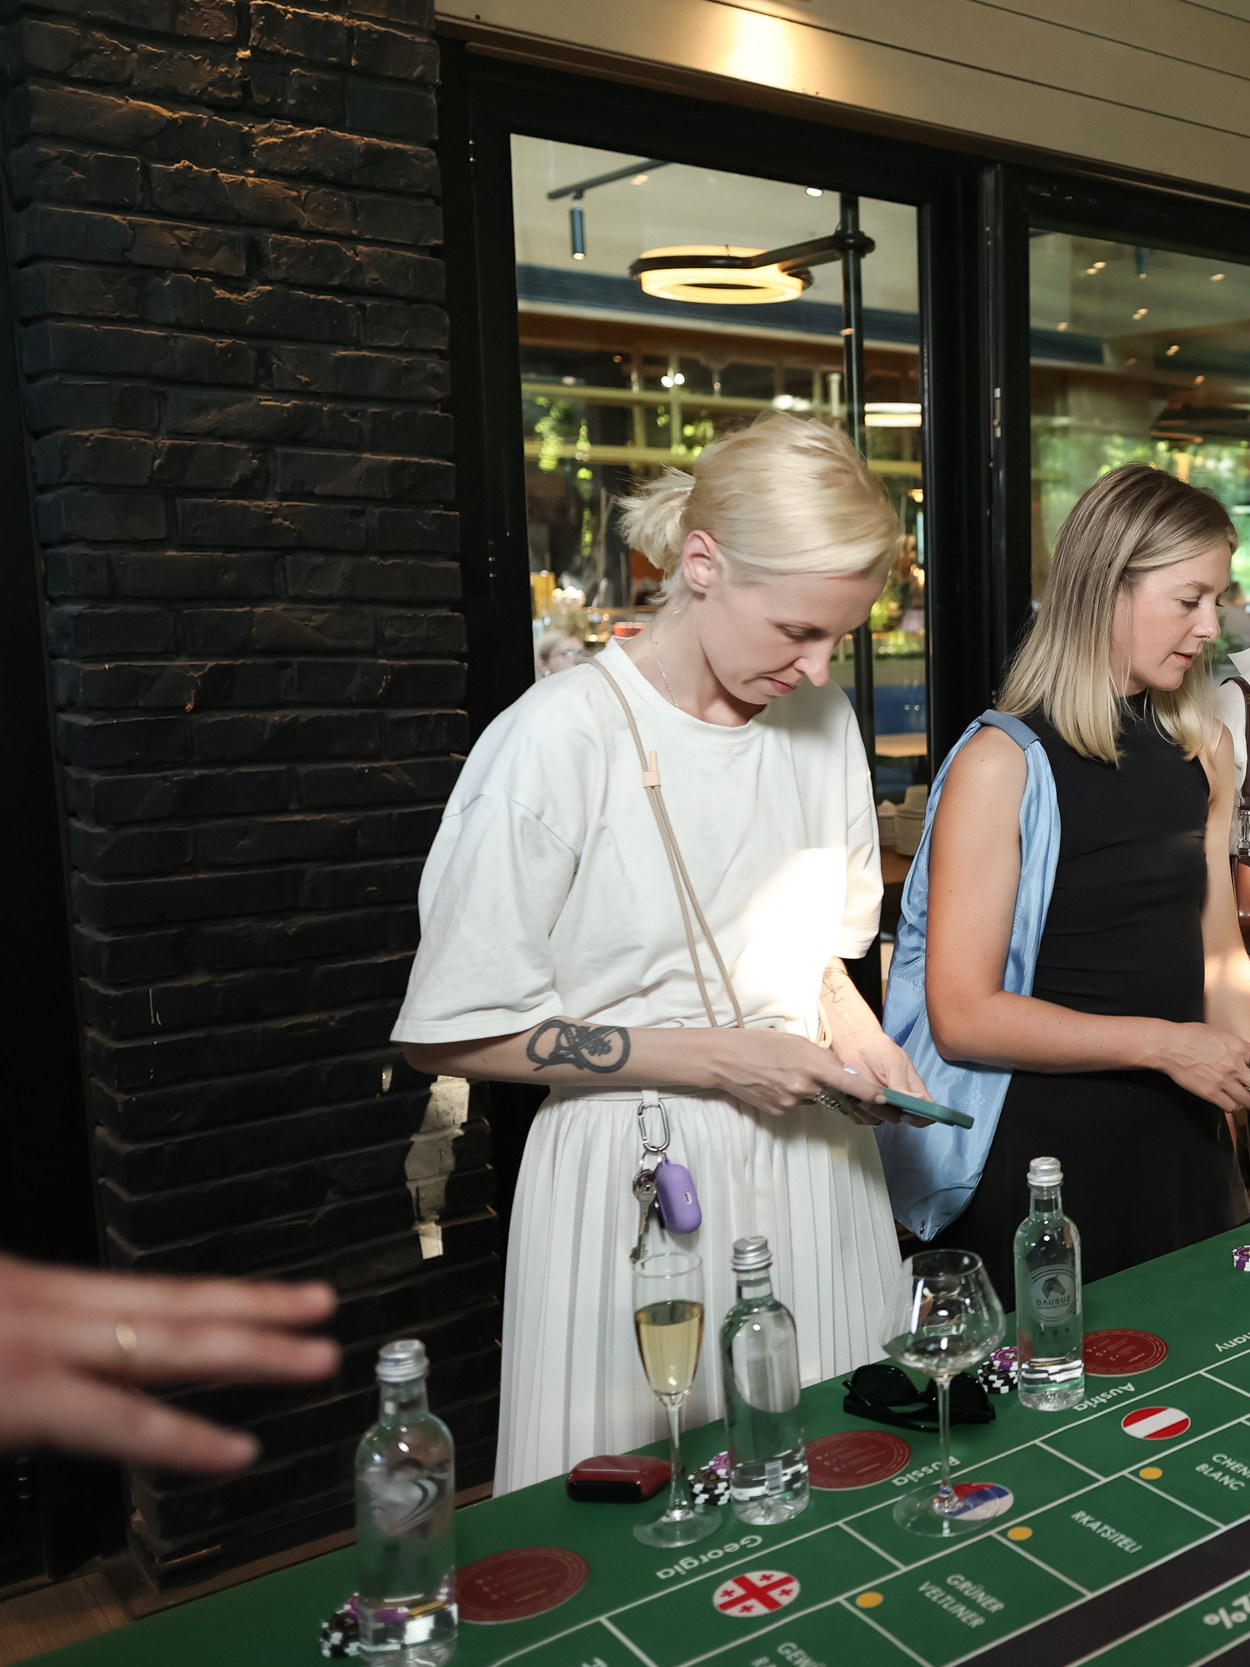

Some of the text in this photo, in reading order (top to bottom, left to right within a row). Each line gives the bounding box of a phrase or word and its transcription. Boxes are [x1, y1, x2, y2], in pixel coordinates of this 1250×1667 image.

[1073, 1381, 1136, 1413] Austria
[1194, 1462, 1246, 1492] BLANC
[1069, 1509, 1143, 1555] RKATSITELI
[654, 1533, 764, 1581] Georgia
[917, 1579, 987, 1630] VELTLINER
[945, 1573, 1007, 1615] GRÜNER
